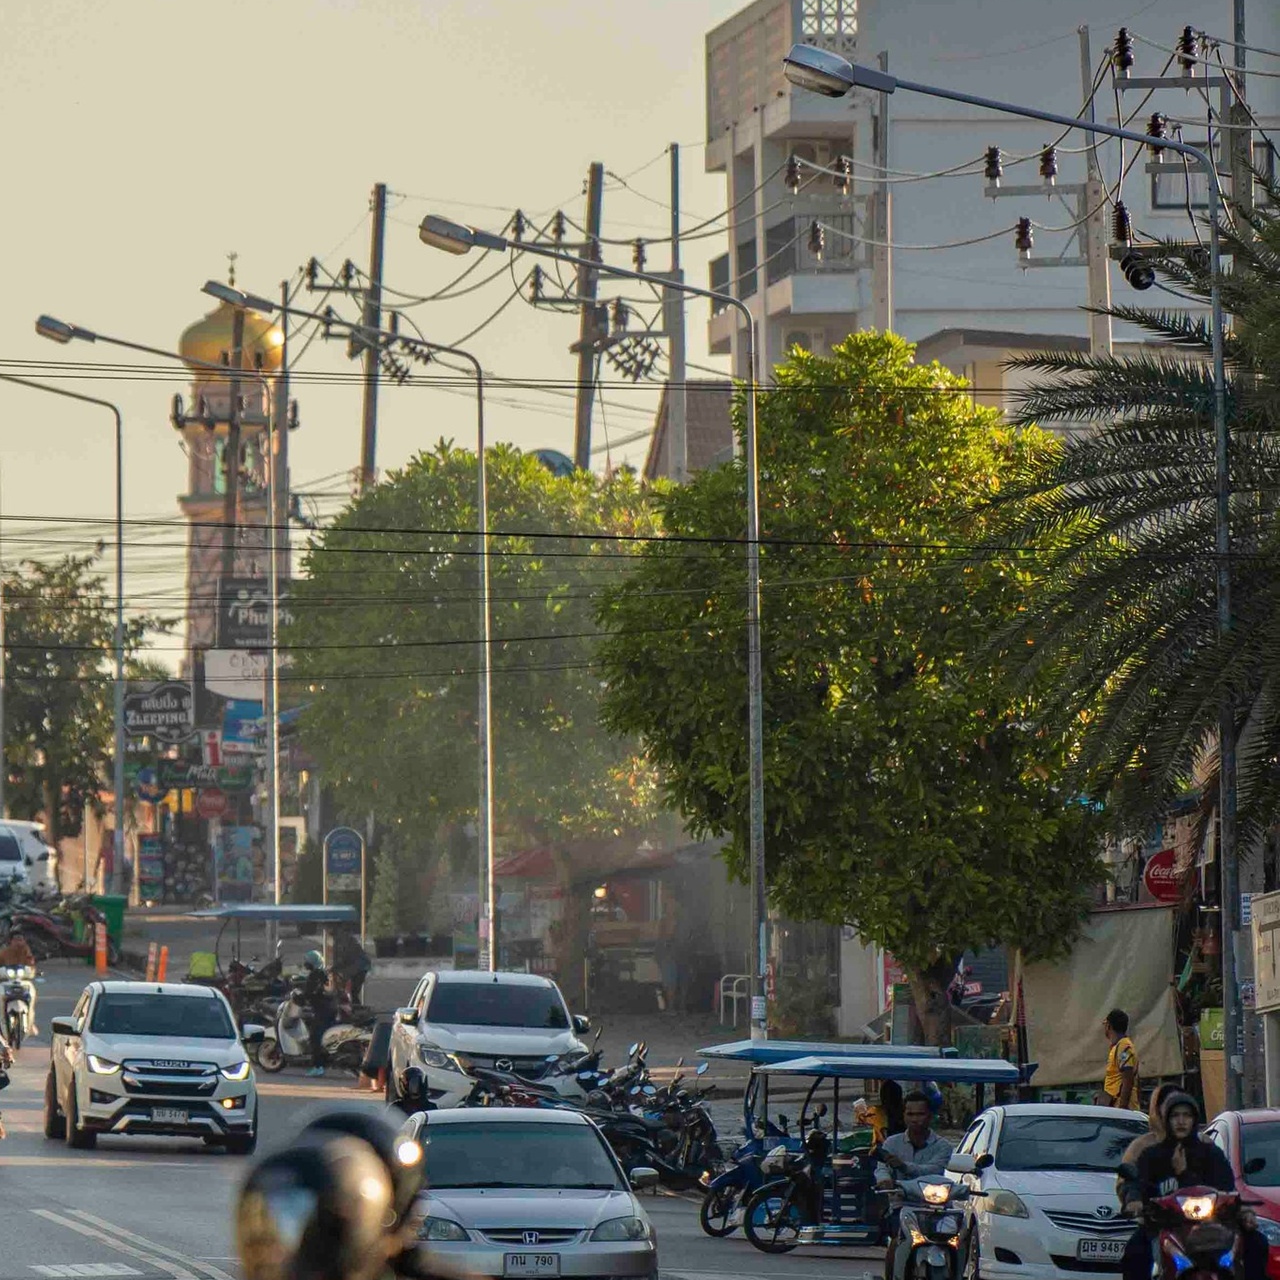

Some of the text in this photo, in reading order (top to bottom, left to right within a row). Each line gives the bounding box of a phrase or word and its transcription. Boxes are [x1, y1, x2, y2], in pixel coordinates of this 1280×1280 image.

[153, 1060, 188, 1068] ISUZU
[1100, 1241, 1126, 1253] 9487
[534, 1255, 553, 1266] 790
